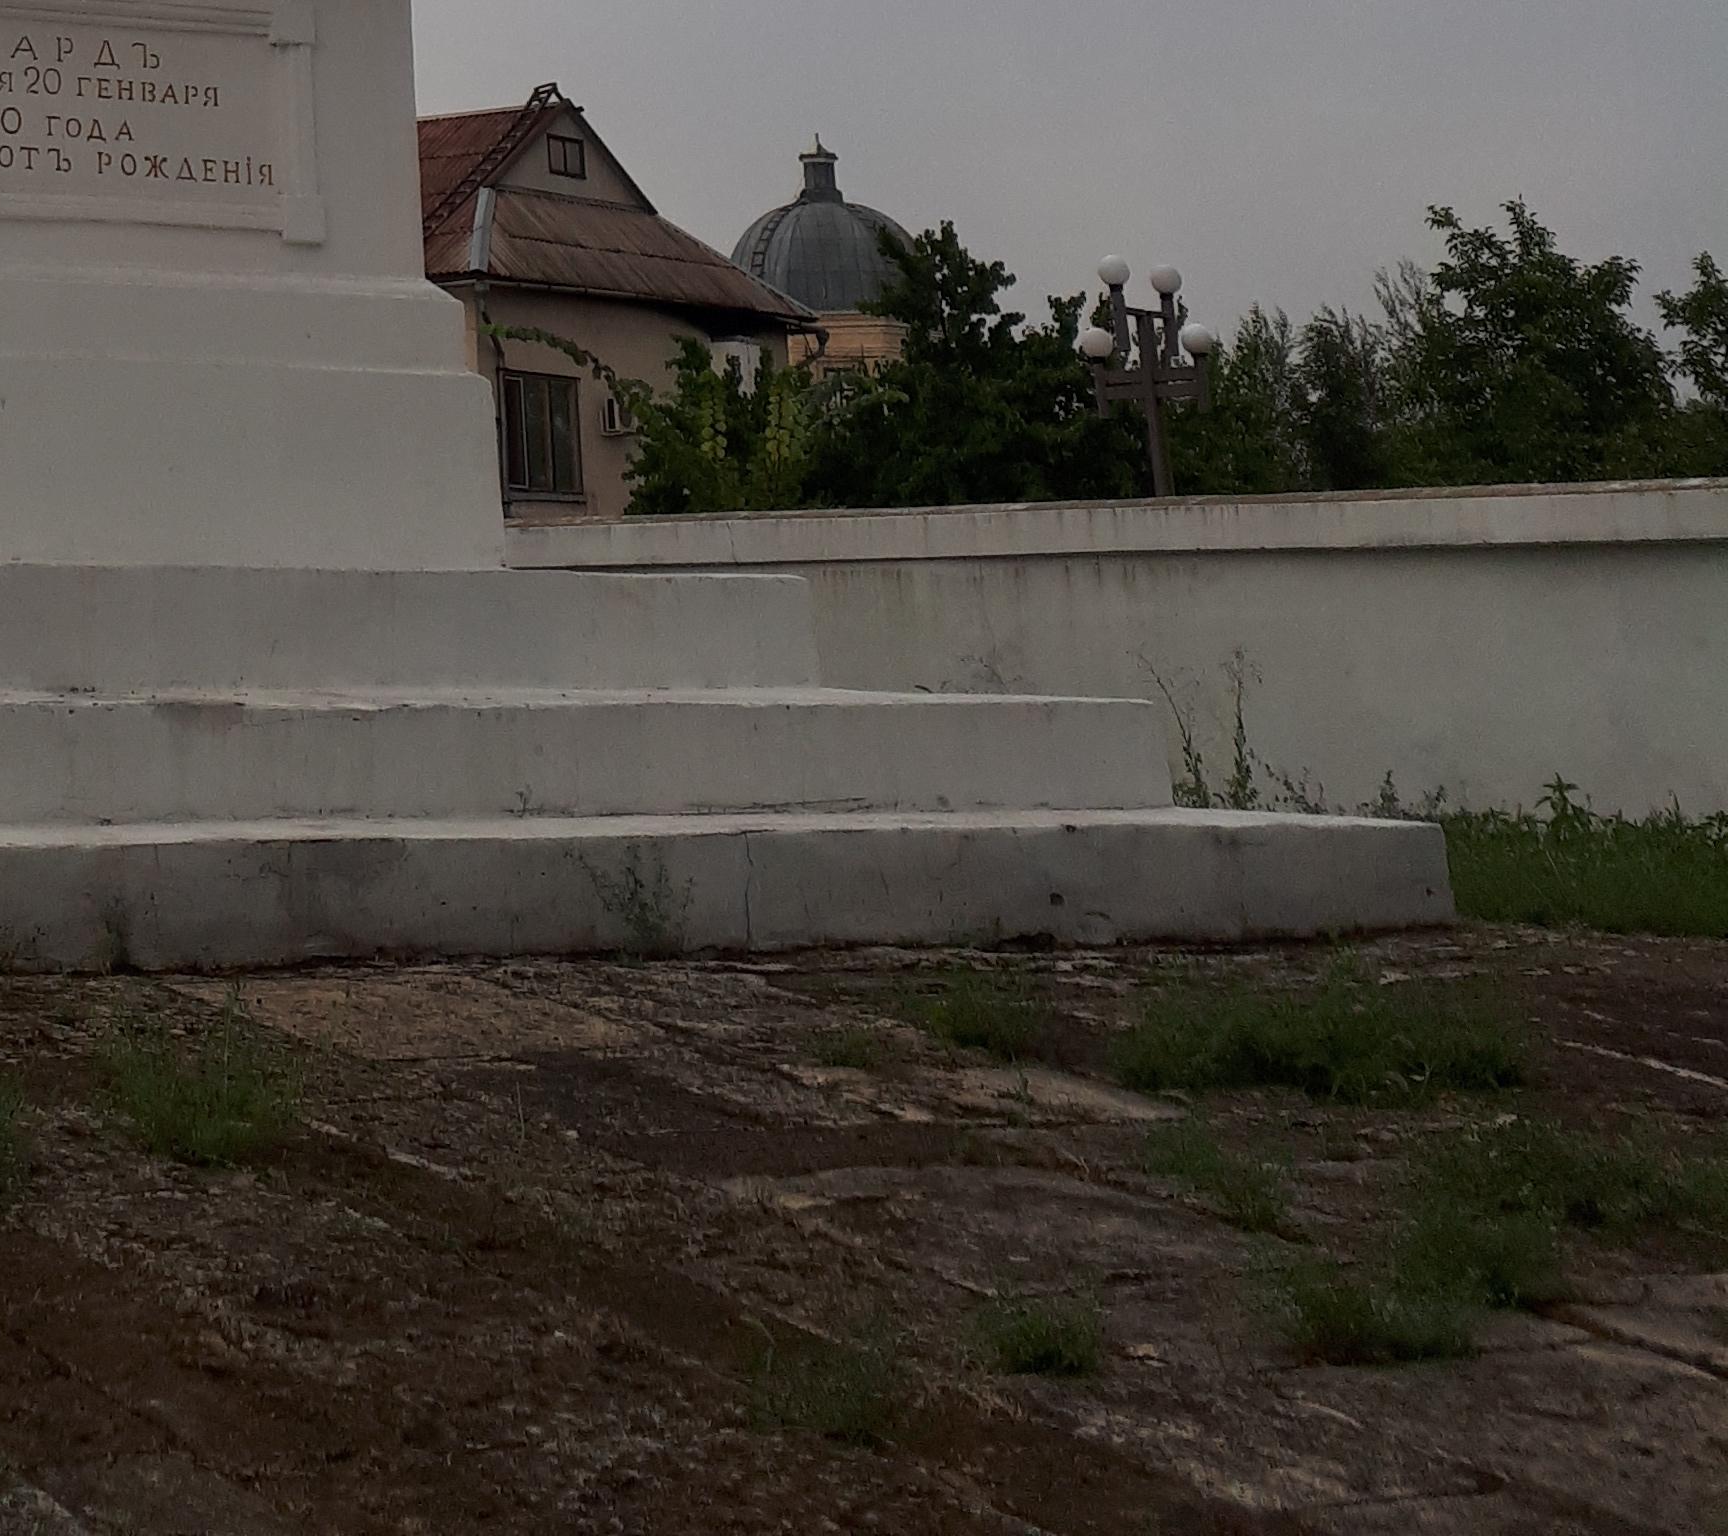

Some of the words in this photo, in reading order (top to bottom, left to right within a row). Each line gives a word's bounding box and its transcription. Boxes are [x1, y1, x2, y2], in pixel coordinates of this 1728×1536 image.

[23, 65, 63, 95] 20
[75, 76, 221, 108] ГЕНВАРЯ
[45, 115, 135, 144] ГОДА
